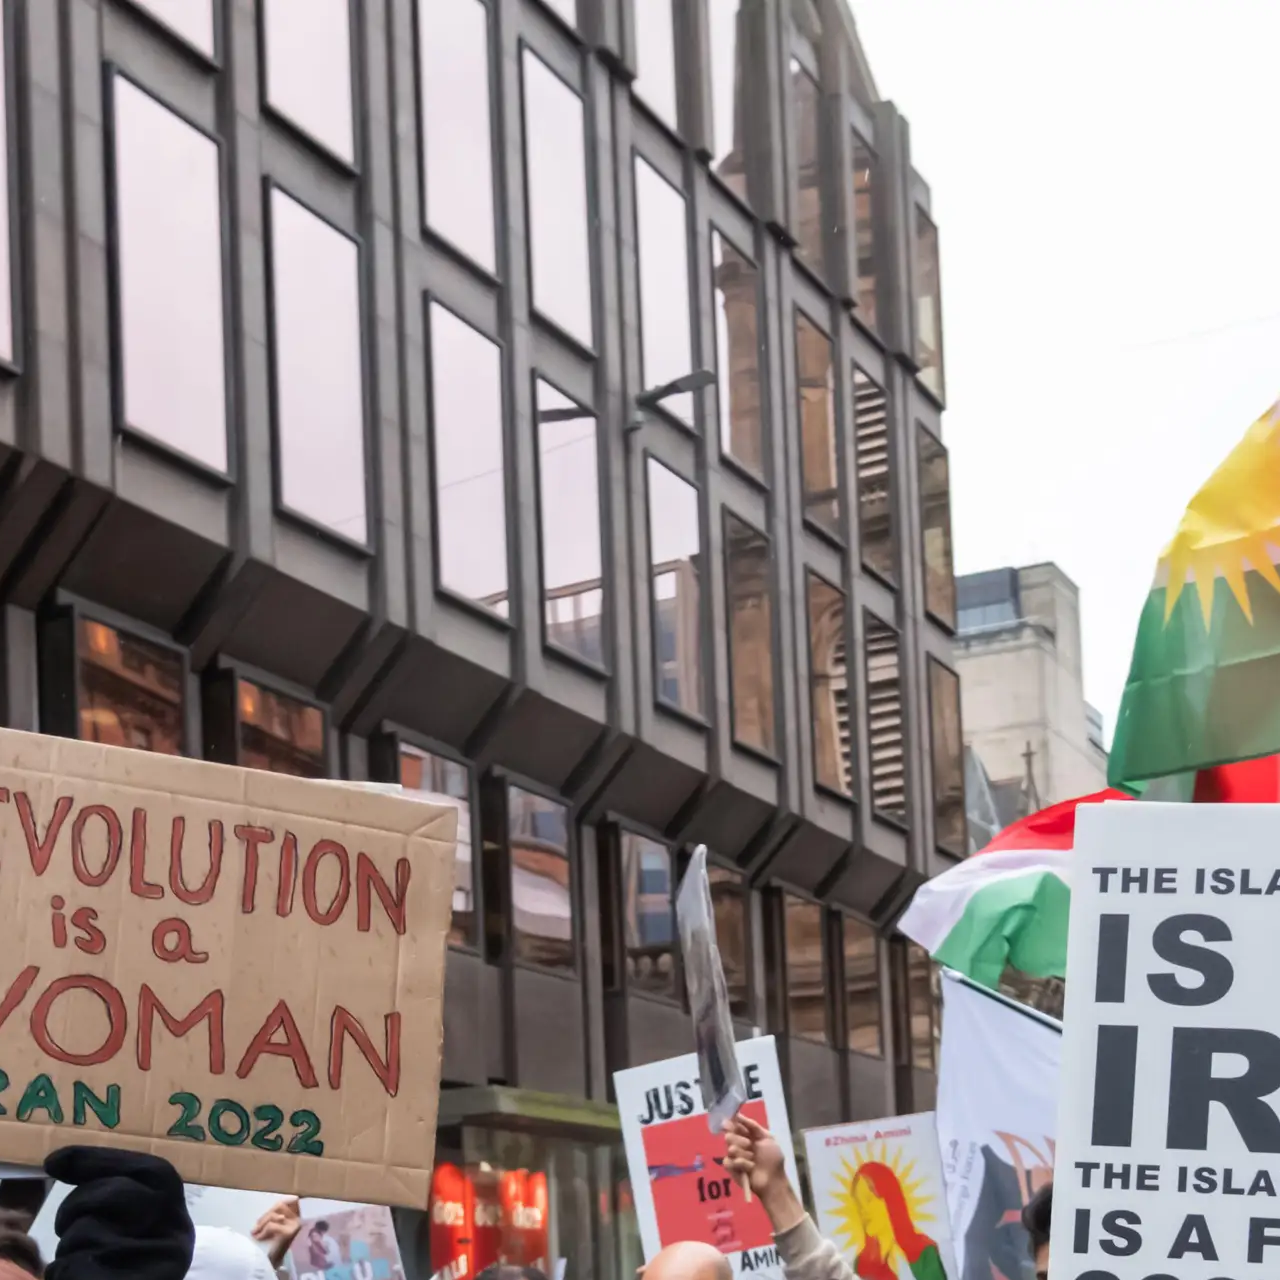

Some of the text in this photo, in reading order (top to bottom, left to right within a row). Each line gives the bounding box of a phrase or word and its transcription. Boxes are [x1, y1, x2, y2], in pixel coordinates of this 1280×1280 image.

[1092, 867, 1178, 894] THE
[50, 895, 209, 963] is a
[1094, 913, 1234, 1007] IS
[167, 1092, 324, 1156] 2022
[638, 1063, 762, 1125] JUSE
[1075, 1161, 1160, 1192] THE
[1073, 1208, 1143, 1257] IS
[1167, 1213, 1219, 1262] A
